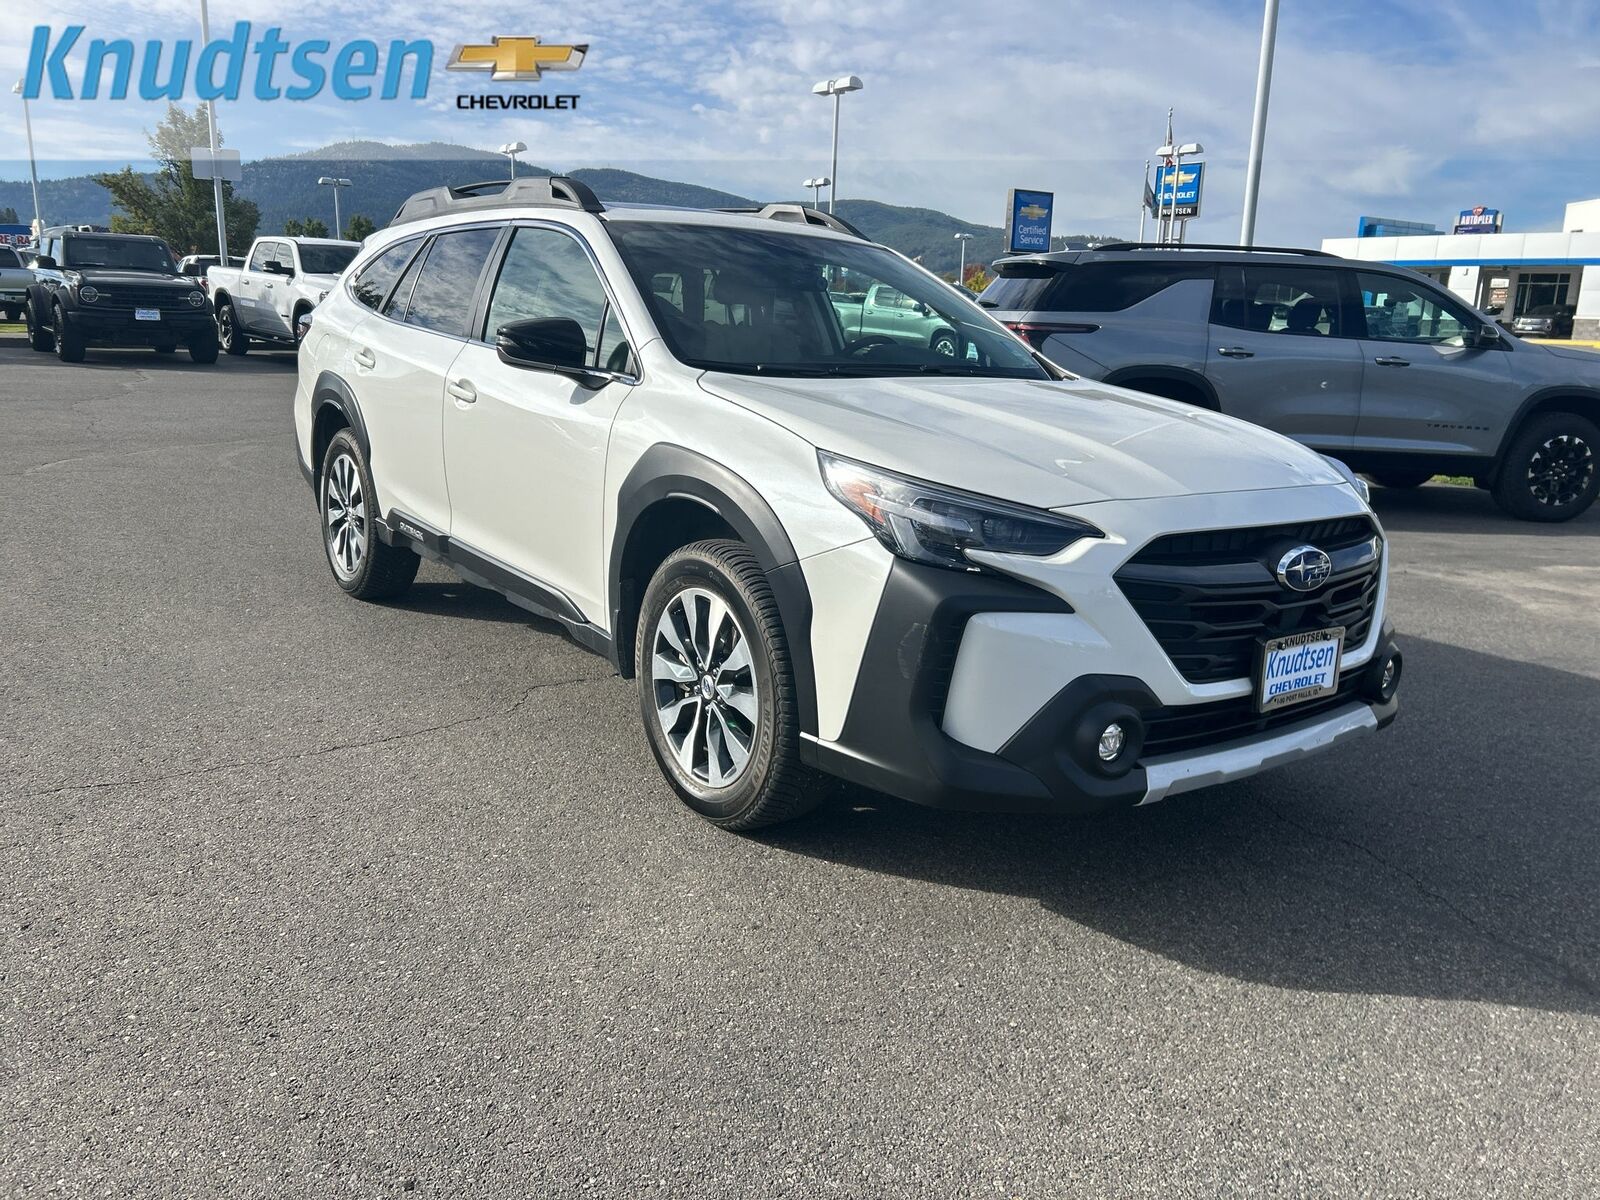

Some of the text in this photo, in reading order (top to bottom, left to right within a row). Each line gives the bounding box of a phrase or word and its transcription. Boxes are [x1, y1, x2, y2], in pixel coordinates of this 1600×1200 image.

[1460, 214, 1494, 225] AUTOPLEX
[1019, 225, 1047, 235] Certified
[1020, 234, 1043, 245] Service
[1284, 631, 1326, 646] KNUDTSEN
[1266, 645, 1334, 680] Knudtsen
[1269, 672, 1327, 695] CHEVROLET
